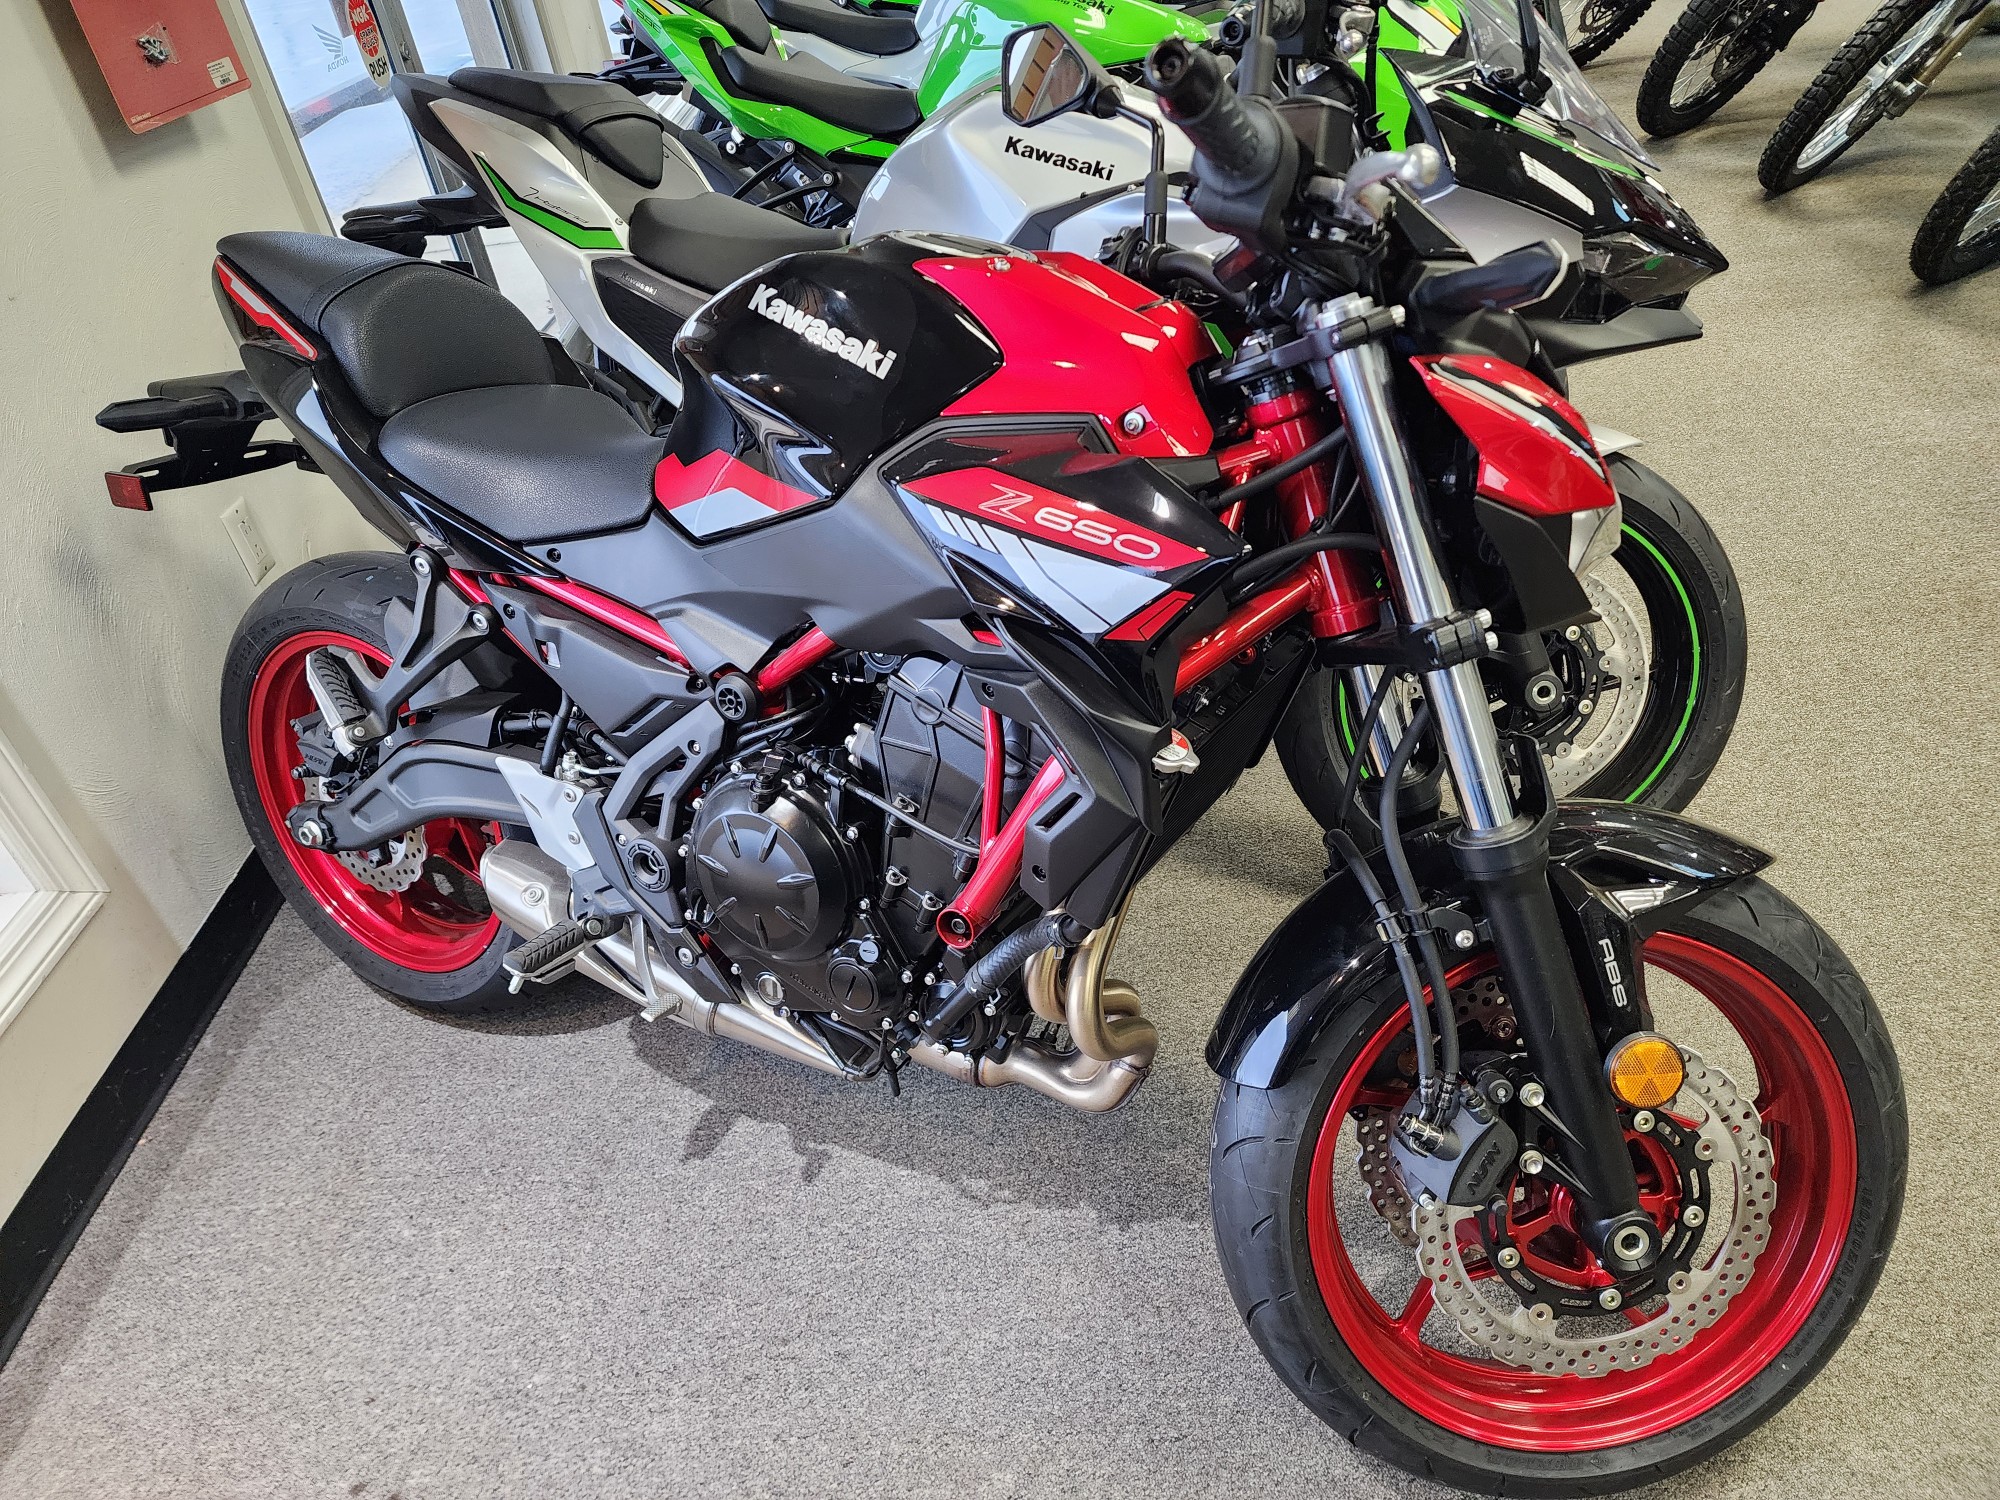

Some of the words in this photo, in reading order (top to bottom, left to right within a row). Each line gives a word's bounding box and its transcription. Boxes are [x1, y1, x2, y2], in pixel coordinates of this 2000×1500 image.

[351, 5, 369, 26] NGK
[360, 26, 375, 38] SPARK
[368, 55, 389, 80] PUSH
[1004, 135, 1115, 181] Kawasaki
[620, 270, 658, 296] Kawasaki
[748, 283, 898, 380] Kawasaki
[1598, 938, 1628, 1007] ABS
